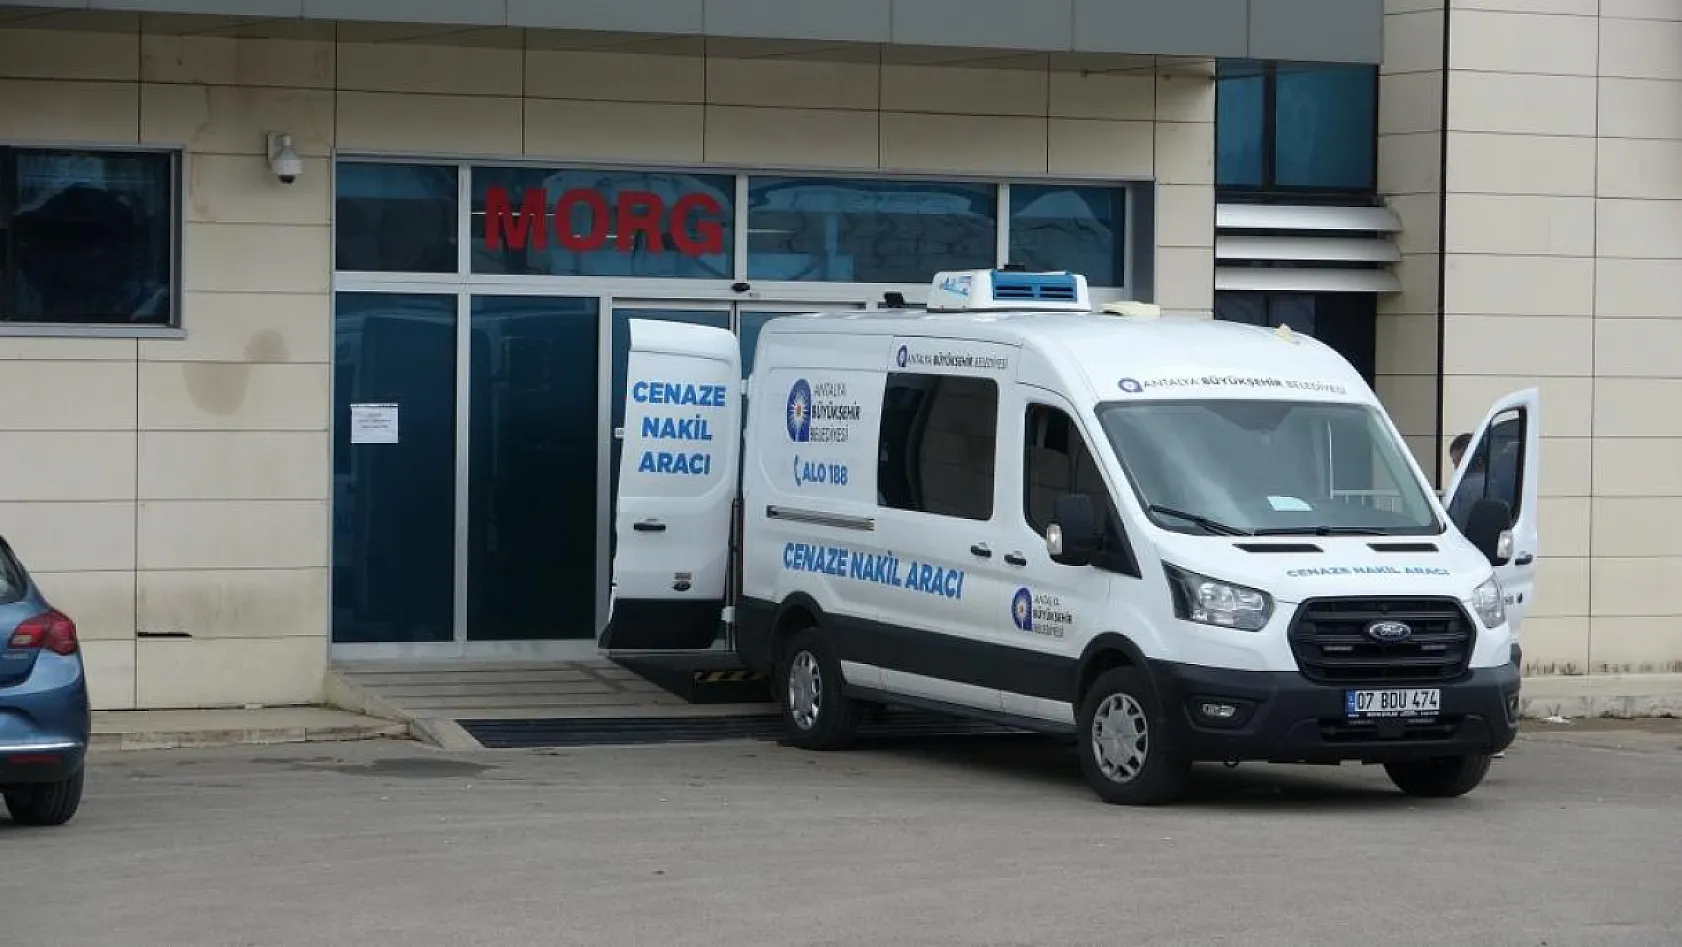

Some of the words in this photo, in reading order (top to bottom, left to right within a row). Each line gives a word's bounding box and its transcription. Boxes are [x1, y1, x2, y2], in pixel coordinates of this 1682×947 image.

[484, 187, 725, 257] MORG
[633, 380, 726, 407] CENAZE
[814, 382, 847, 397] ANTALYA
[641, 413, 713, 441] NAKİL
[637, 450, 712, 475] ARACI
[802, 461, 827, 483] ALO
[829, 464, 848, 486] 188
[783, 541, 848, 578] CENAZE
[850, 550, 902, 588] NAKİL
[905, 560, 965, 600] ARACI
[1286, 566, 1350, 577] CENAZE
[1358, 692, 1375, 710] 07
[1381, 690, 1407, 709] BDU
[1412, 690, 1438, 709] 474
